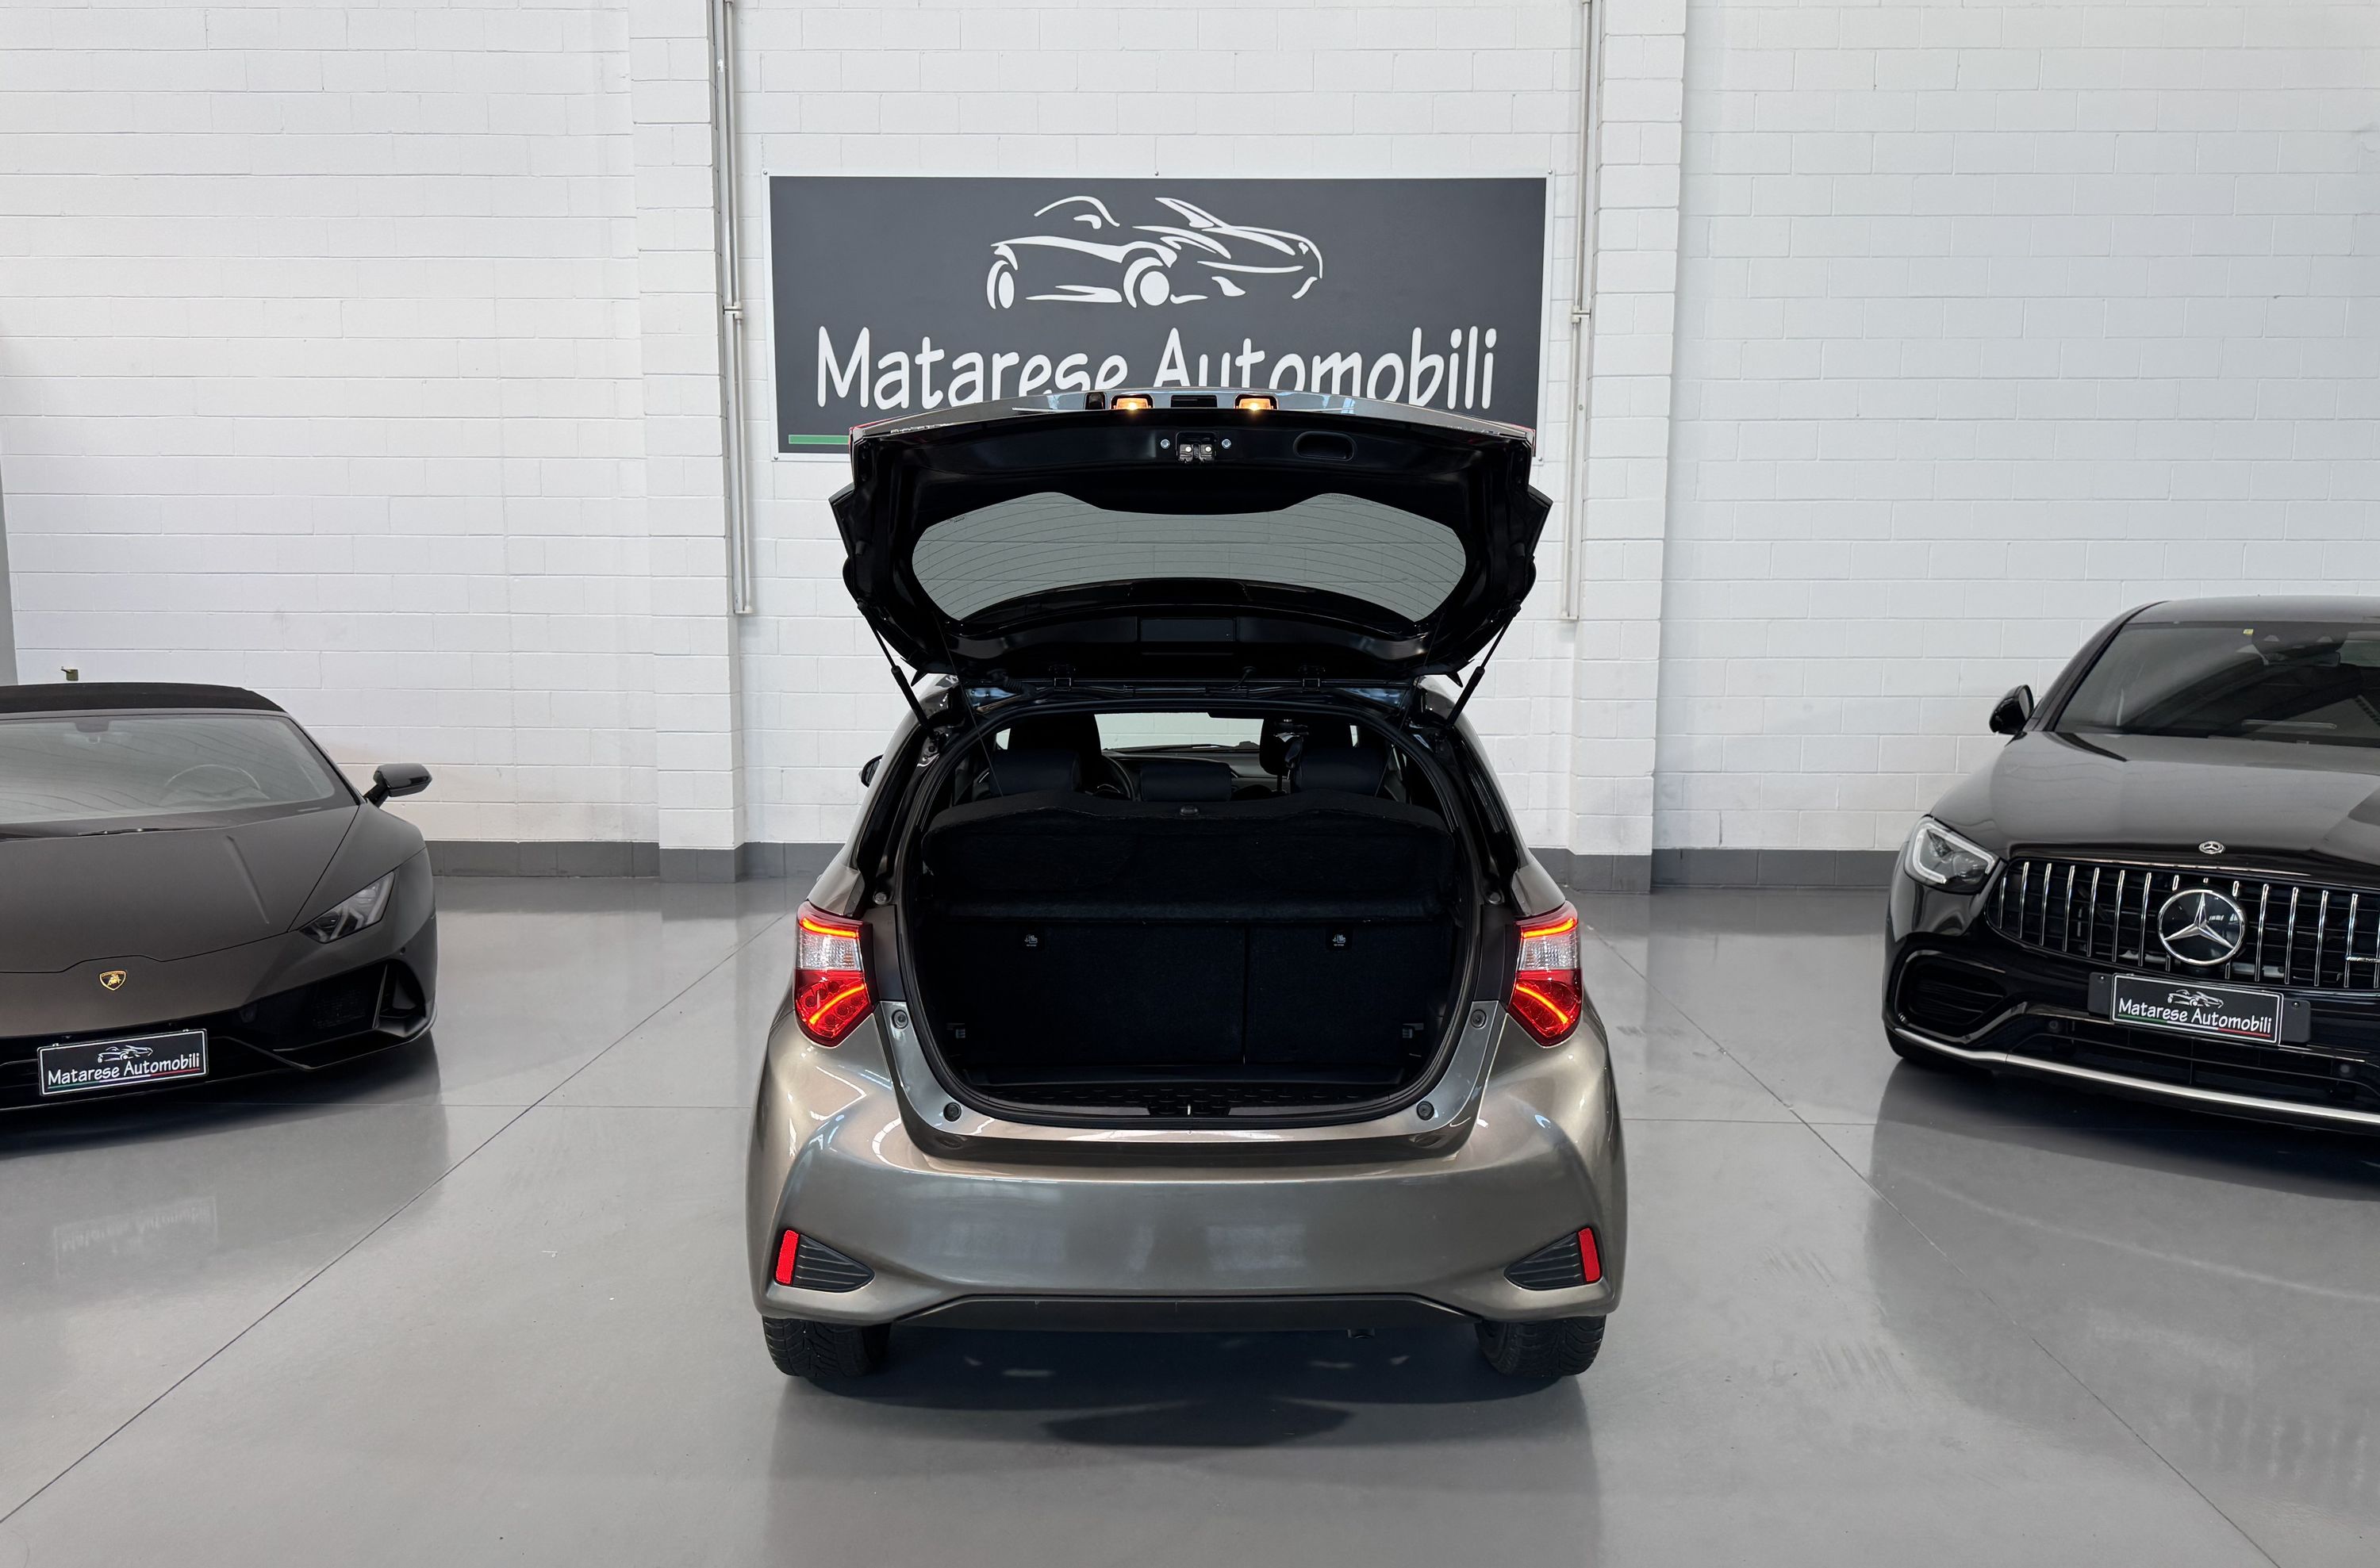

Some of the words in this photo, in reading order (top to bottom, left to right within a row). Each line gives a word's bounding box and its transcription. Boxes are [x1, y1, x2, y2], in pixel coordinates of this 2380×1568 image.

[817, 326, 1128, 410] Matarese
[1153, 326, 1497, 410] Automobili
[2118, 997, 2188, 1022] Matarese
[2191, 1007, 2272, 1034] Automobili
[48, 1066, 120, 1086] Matarese
[124, 1052, 200, 1075] Automobili
